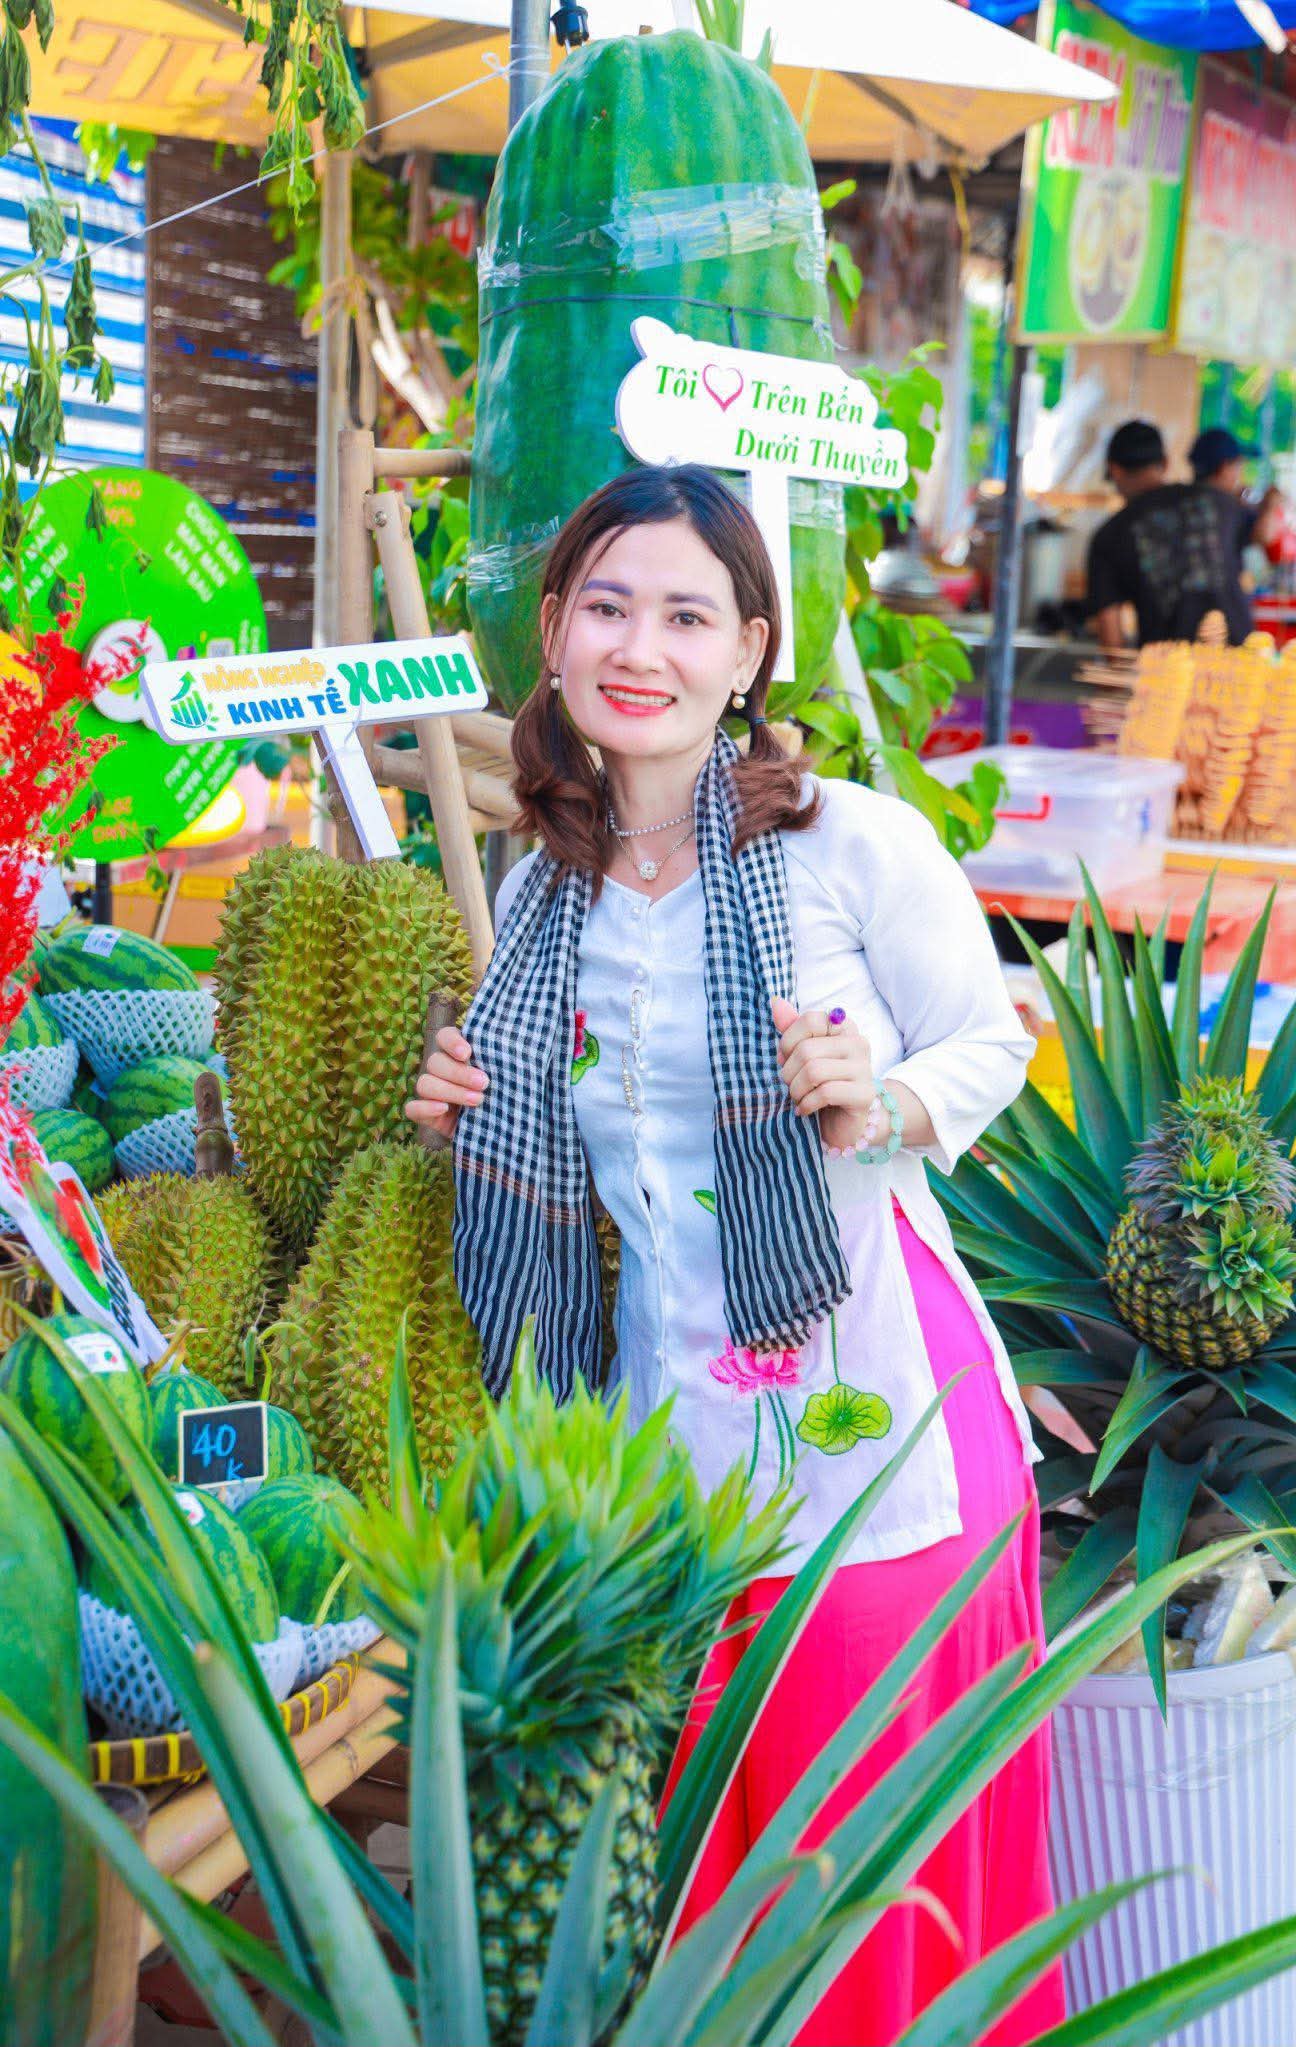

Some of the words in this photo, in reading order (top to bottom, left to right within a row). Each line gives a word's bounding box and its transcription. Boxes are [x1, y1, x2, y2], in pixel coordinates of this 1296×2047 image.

[656, 364, 698, 400] Tôi
[751, 380, 807, 416] Trên
[817, 386, 863, 424] Bến
[735, 428, 799, 464] Dưới
[809, 439, 899, 480] Thuyền
[202, 664, 259, 692] NÔNG
[258, 656, 325, 689] NGHIỆP
[337, 653, 477, 707] XANH
[227, 697, 305, 726] KINH
[307, 678, 347, 716] TẾ
[192, 1422, 237, 1468] 40
